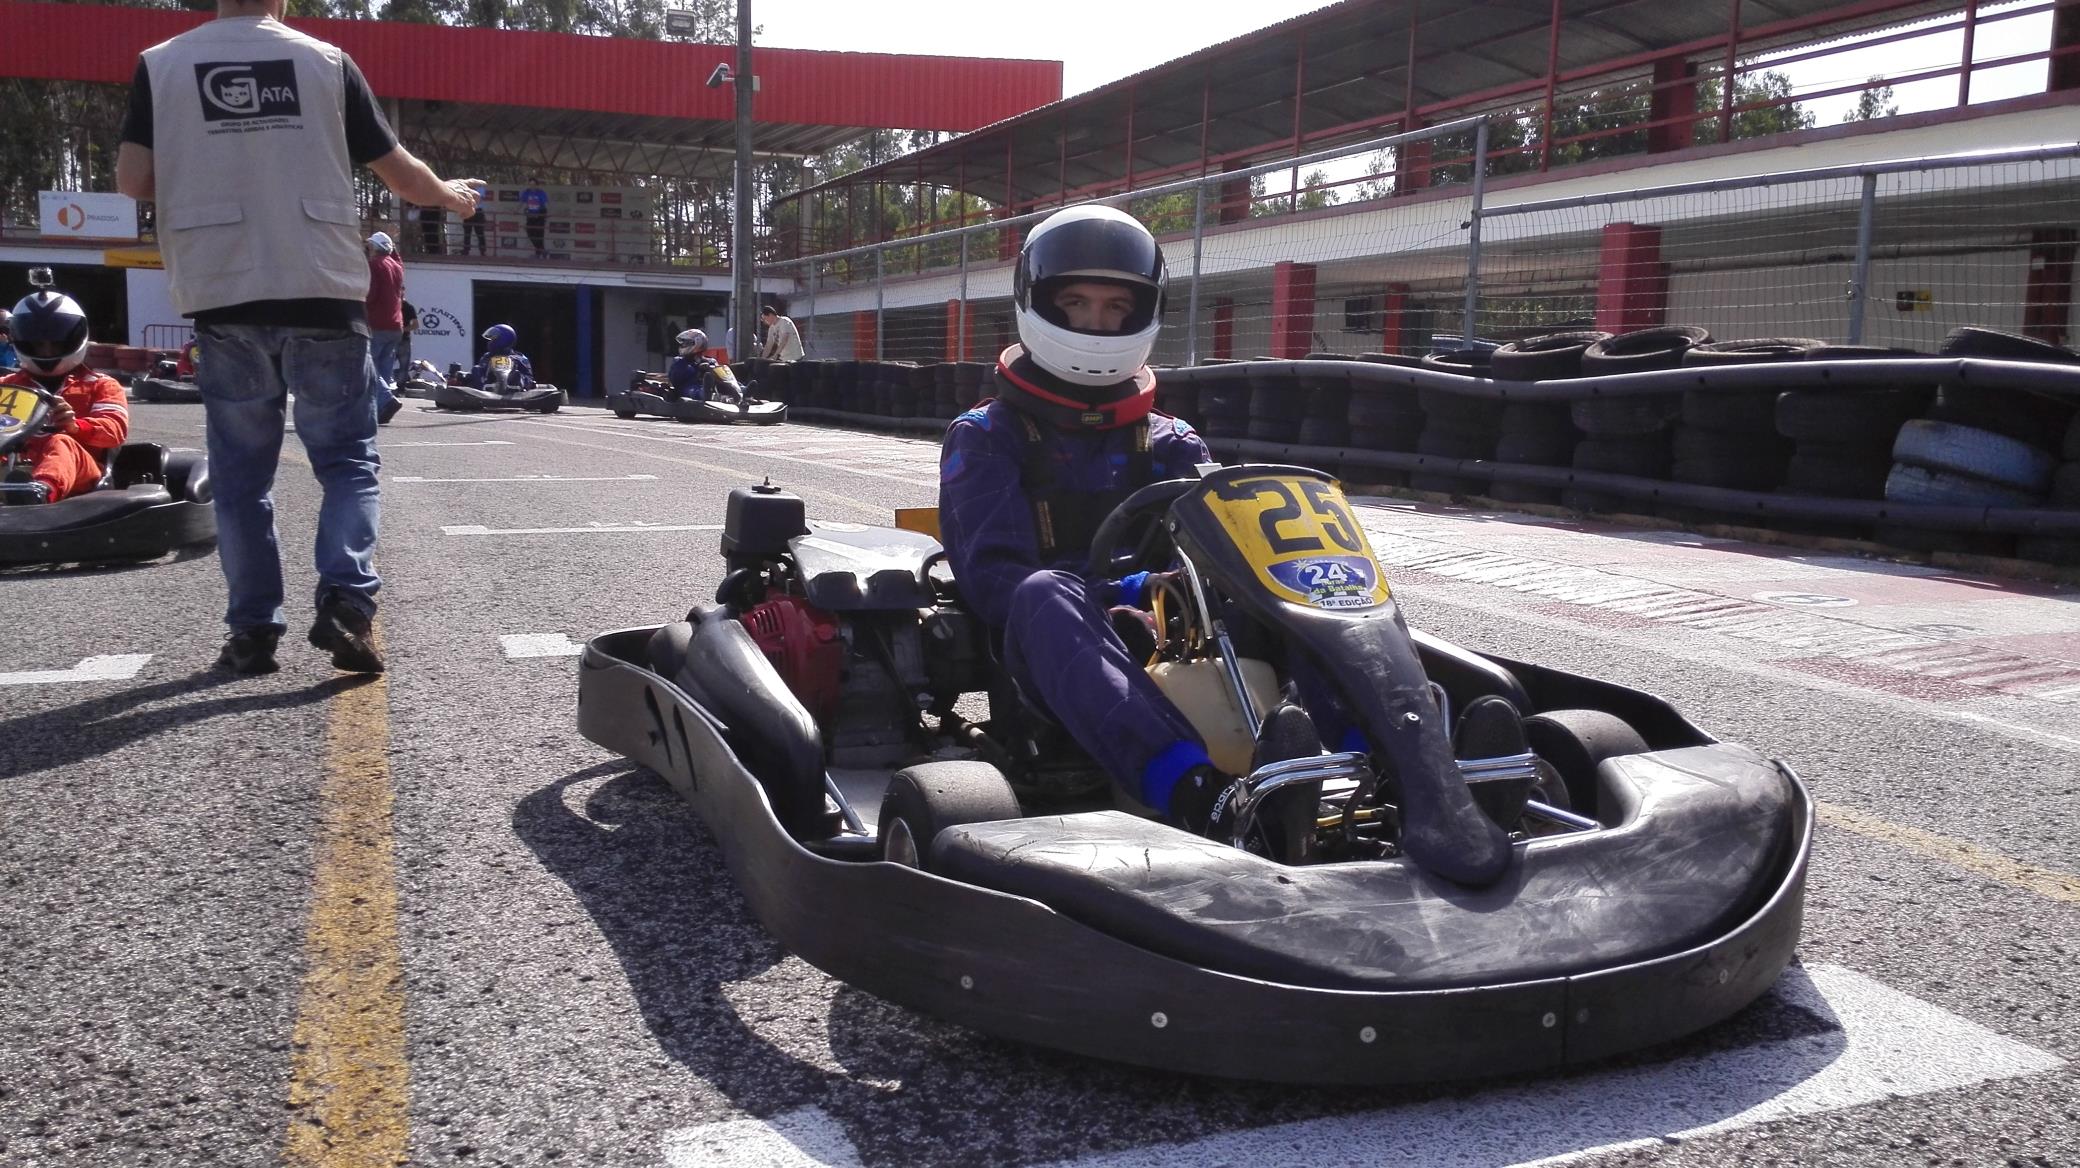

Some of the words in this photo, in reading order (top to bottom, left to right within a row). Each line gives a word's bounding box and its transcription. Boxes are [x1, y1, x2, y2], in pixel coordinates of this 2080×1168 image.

[431, 307, 465, 337] KARTING
[0, 388, 19, 416] 4
[1238, 480, 1363, 555] 25
[1304, 563, 1348, 585] 24
[1339, 597, 1373, 607] EDIÇÃO
